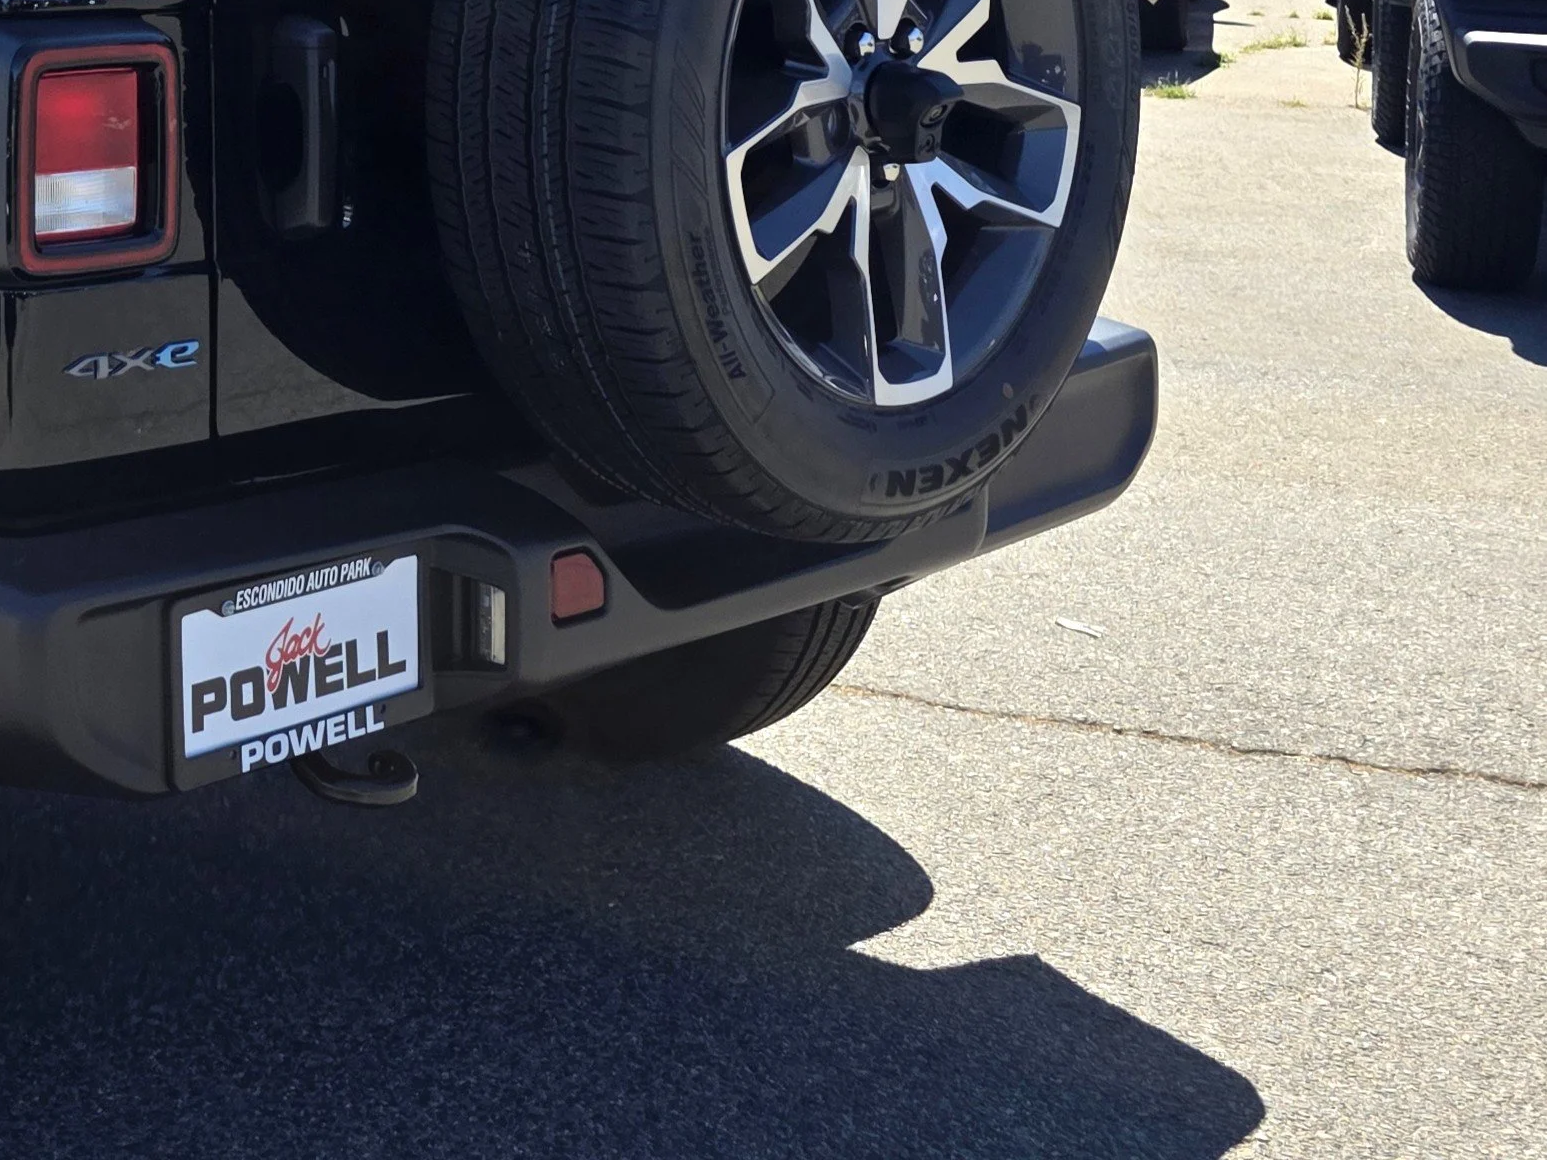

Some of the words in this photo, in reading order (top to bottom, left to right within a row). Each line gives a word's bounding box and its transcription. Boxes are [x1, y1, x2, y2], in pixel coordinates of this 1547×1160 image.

[687, 231, 746, 379] All-Weather
[62, 339, 200, 380] 4xe
[884, 404, 1028, 498] NEXEN
[234, 574, 305, 612] ESCONDIDO
[306, 564, 339, 592] AUTO
[340, 556, 372, 584] PARK
[191, 629, 407, 735] POWELL
[264, 612, 332, 693] Jack
[241, 705, 385, 774] POWELL
